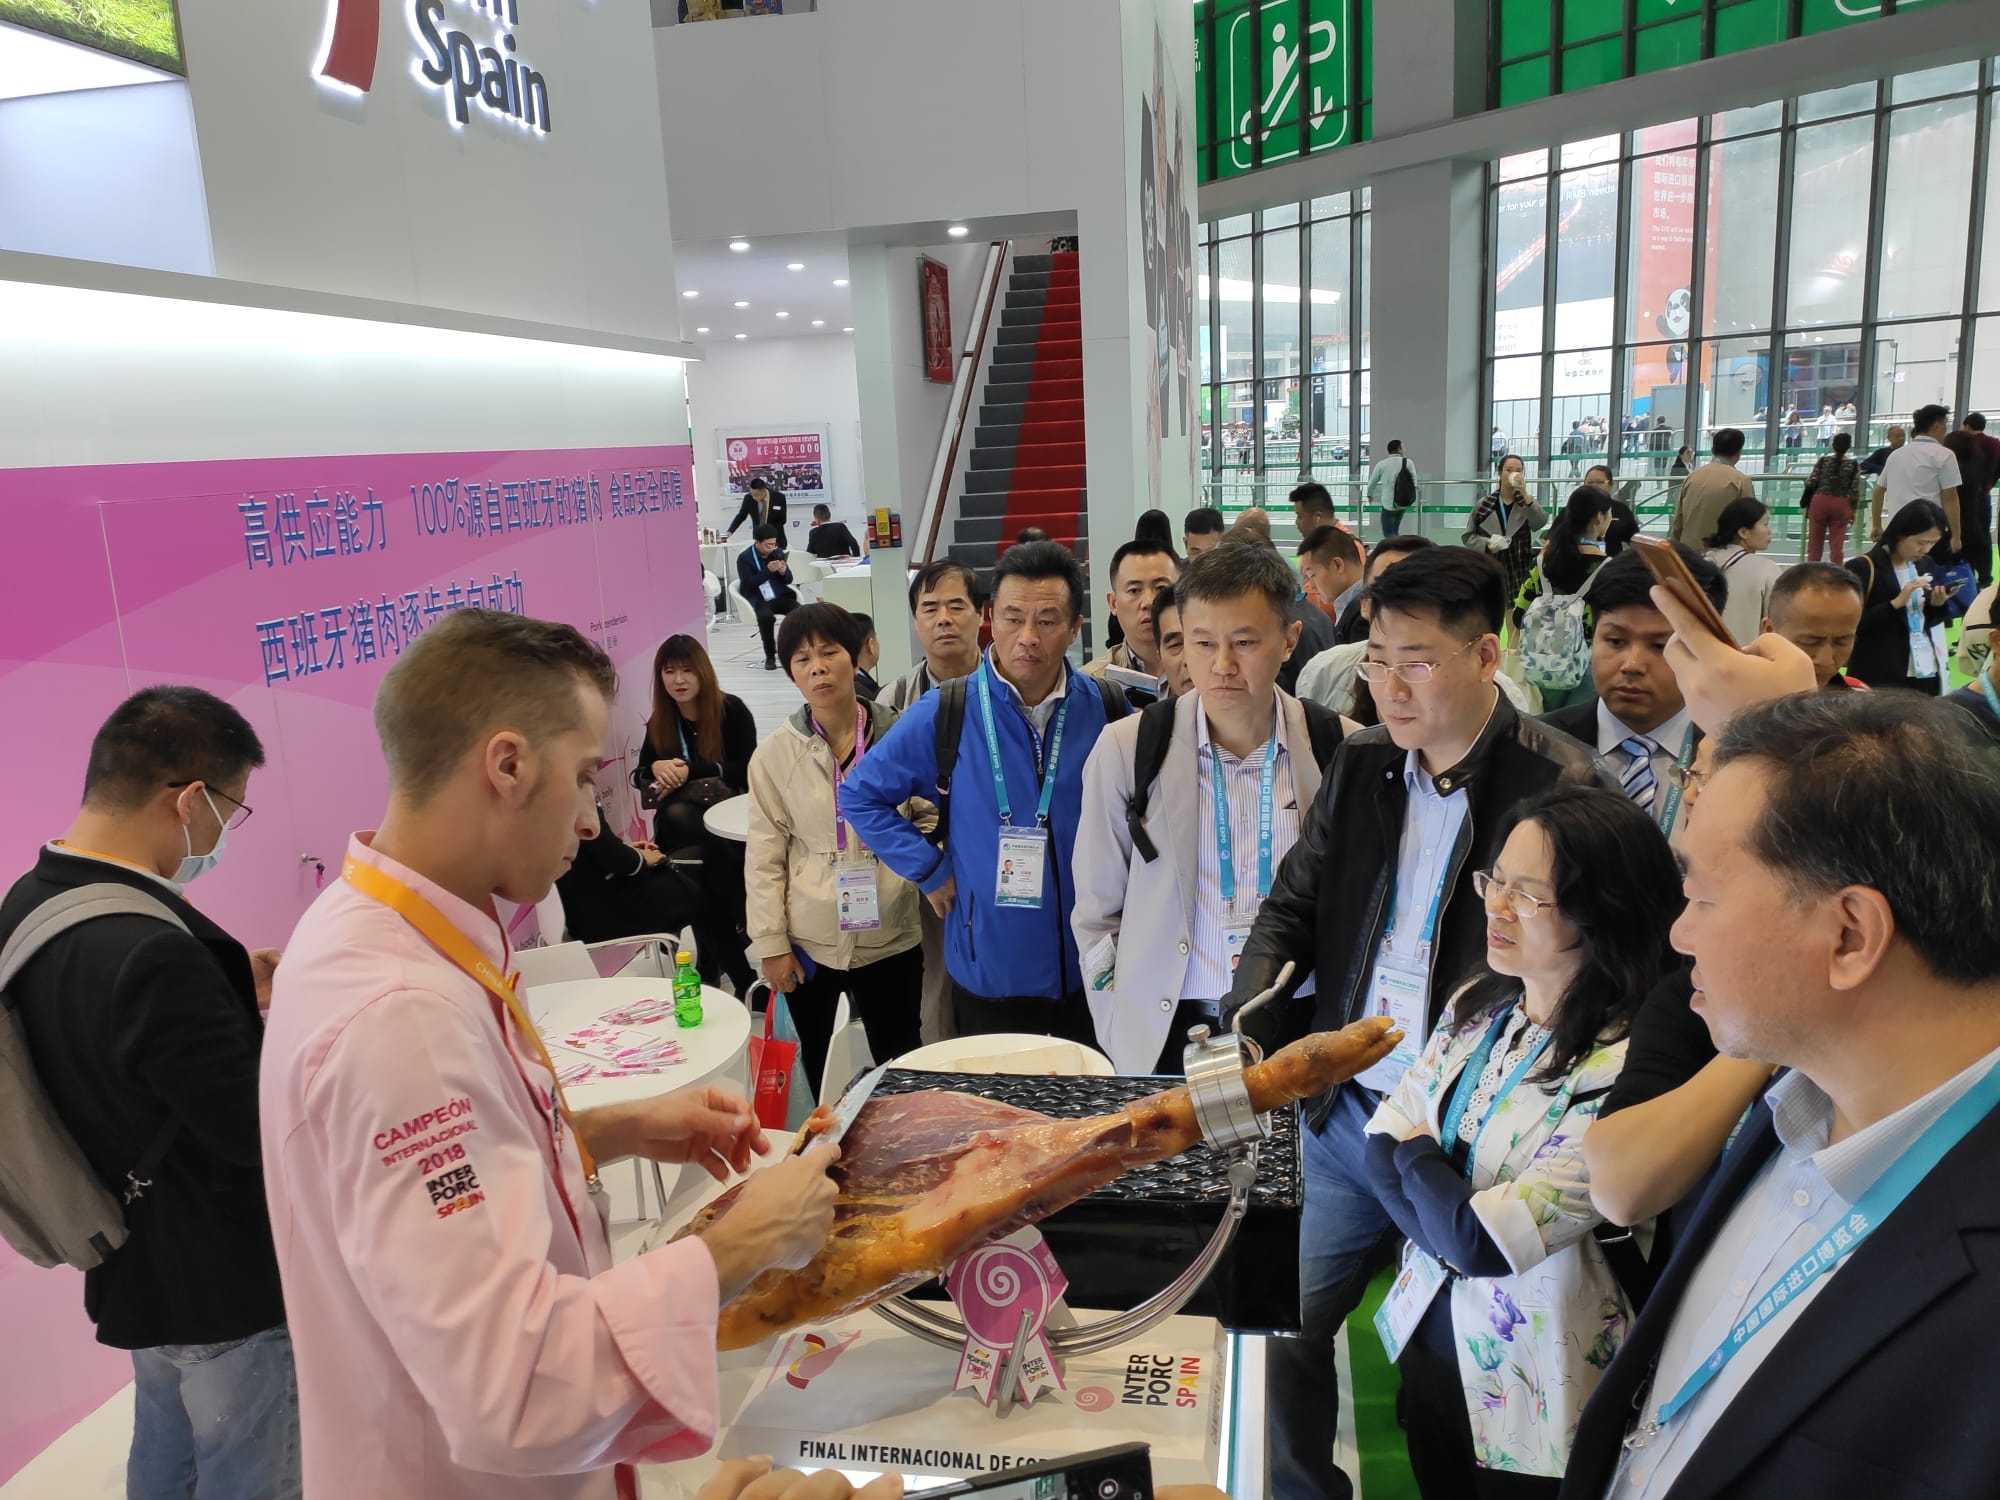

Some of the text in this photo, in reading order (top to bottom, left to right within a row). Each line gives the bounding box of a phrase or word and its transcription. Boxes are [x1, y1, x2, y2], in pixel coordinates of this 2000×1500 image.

[414, 0, 552, 133] Spain
[238, 469, 684, 570] 高供应能力 100%源自西班牙的猪肉 食品安全保障
[372, 1097, 472, 1151] CAMPEÓN
[417, 1142, 467, 1175] 2018
[425, 1163, 476, 1194] INTER
[430, 1175, 481, 1206] PORC
[436, 1190, 486, 1219] SPAIN
[1733, 1212, 1869, 1344] 中国国际进口博览会
[1121, 1353, 1150, 1405] INTER
[1146, 1353, 1174, 1407] PORC
[1176, 1355, 1201, 1408] SPAIN
[800, 1440, 847, 1460] FINAL
[851, 1443, 985, 1471] INTERNACIONAL
[989, 1454, 1011, 1472] DE
